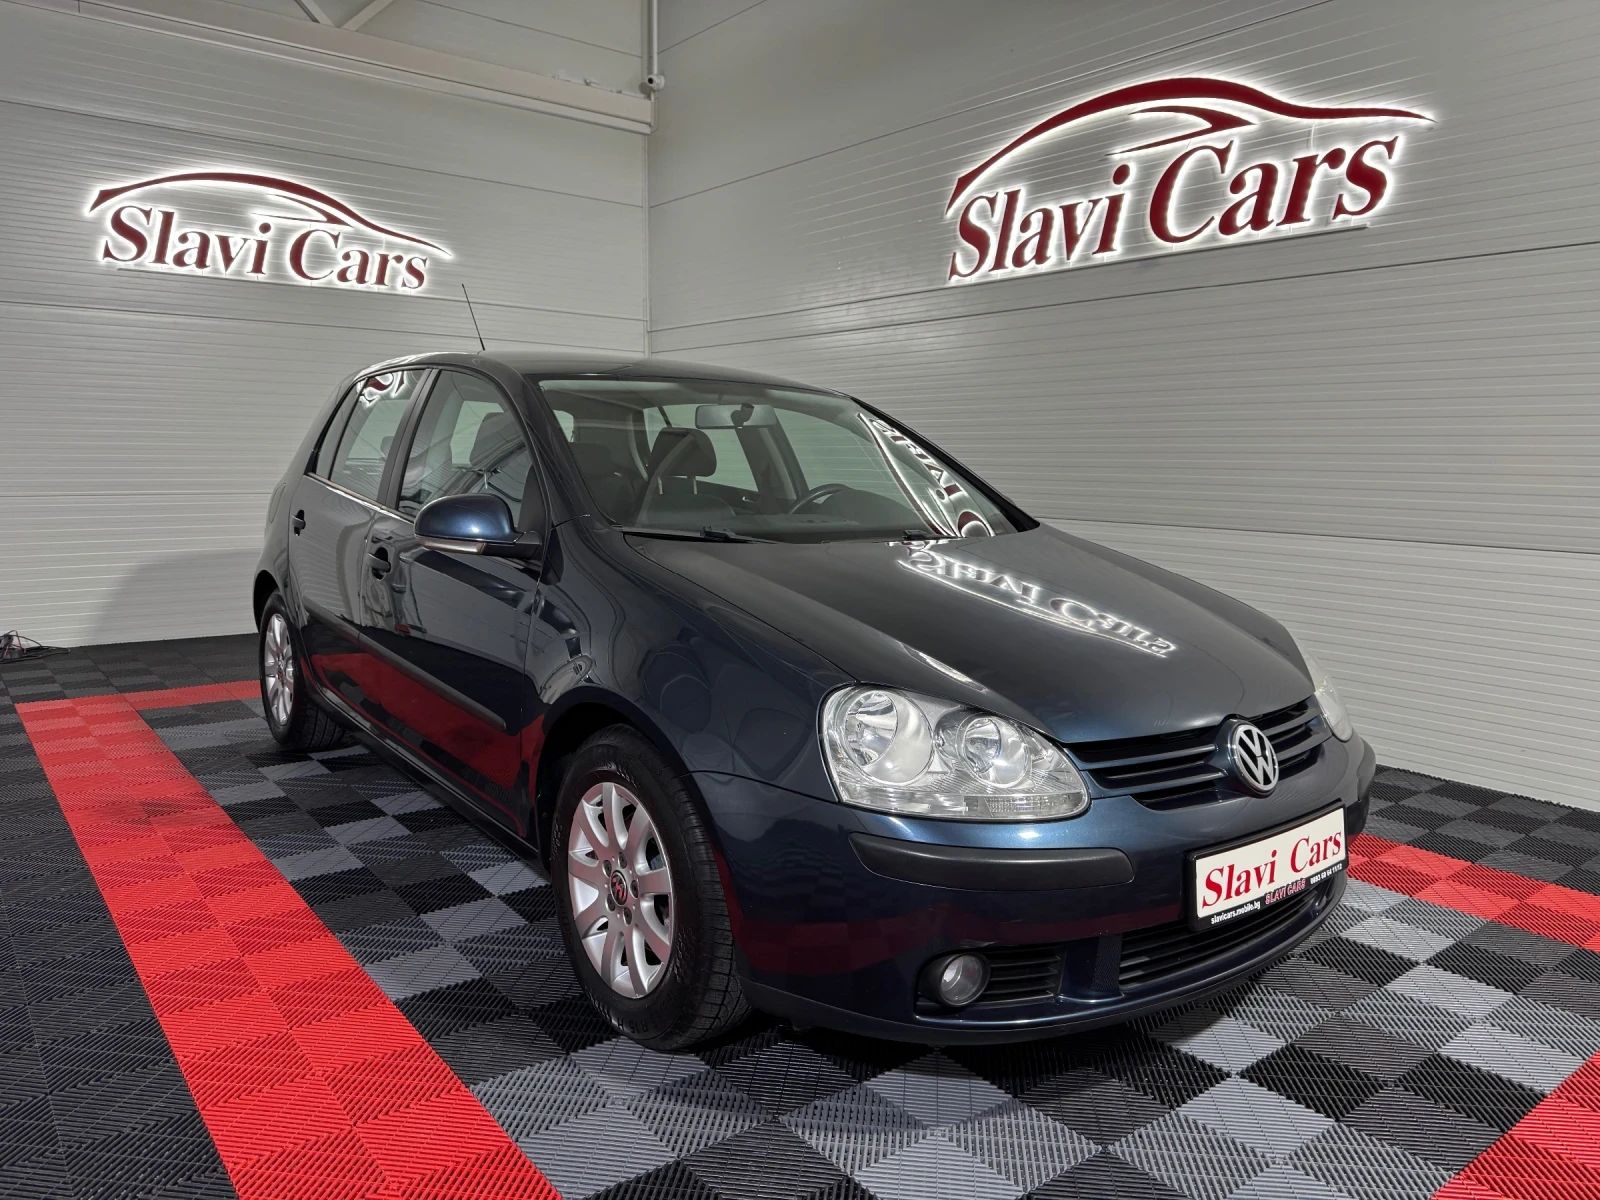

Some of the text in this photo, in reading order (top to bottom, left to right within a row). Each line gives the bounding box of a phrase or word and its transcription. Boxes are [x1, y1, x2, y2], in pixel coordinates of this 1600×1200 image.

[102, 205, 429, 290] Slavi Cars
[948, 135, 1400, 281] Slavi Cars
[1201, 831, 1342, 909] Slavi Cars
[1210, 900, 1261, 925] slavicars.mobile.bg
[1265, 886, 1286, 905] SLAVI
[1286, 878, 1306, 897] CARS
